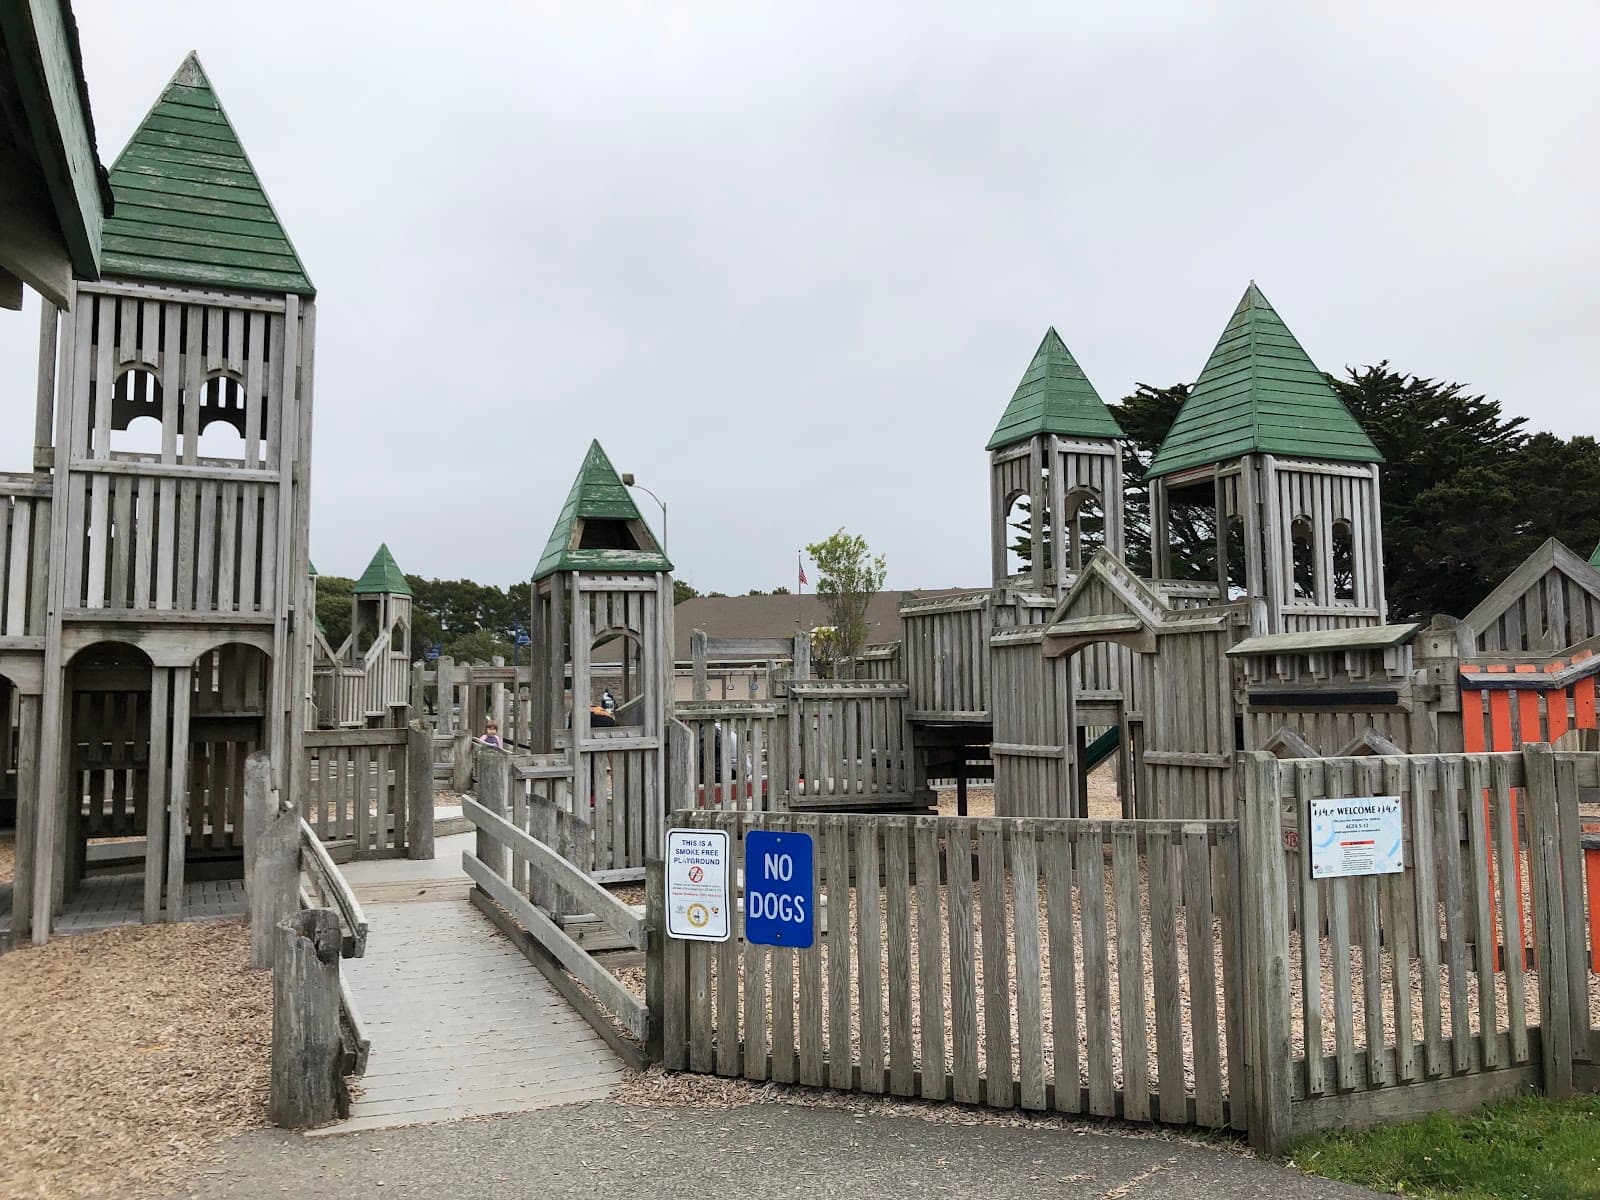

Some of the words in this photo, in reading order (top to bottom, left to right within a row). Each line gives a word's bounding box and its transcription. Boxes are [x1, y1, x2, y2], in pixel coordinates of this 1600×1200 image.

[1337, 805, 1376, 815] WELCOME
[682, 839, 697, 847] THIS
[675, 848, 700, 856] SMOKE
[701, 849, 719, 857] FREE
[673, 857, 720, 866] PLAYGROUND
[764, 852, 793, 882] NO
[749, 890, 805, 924] DOGS
